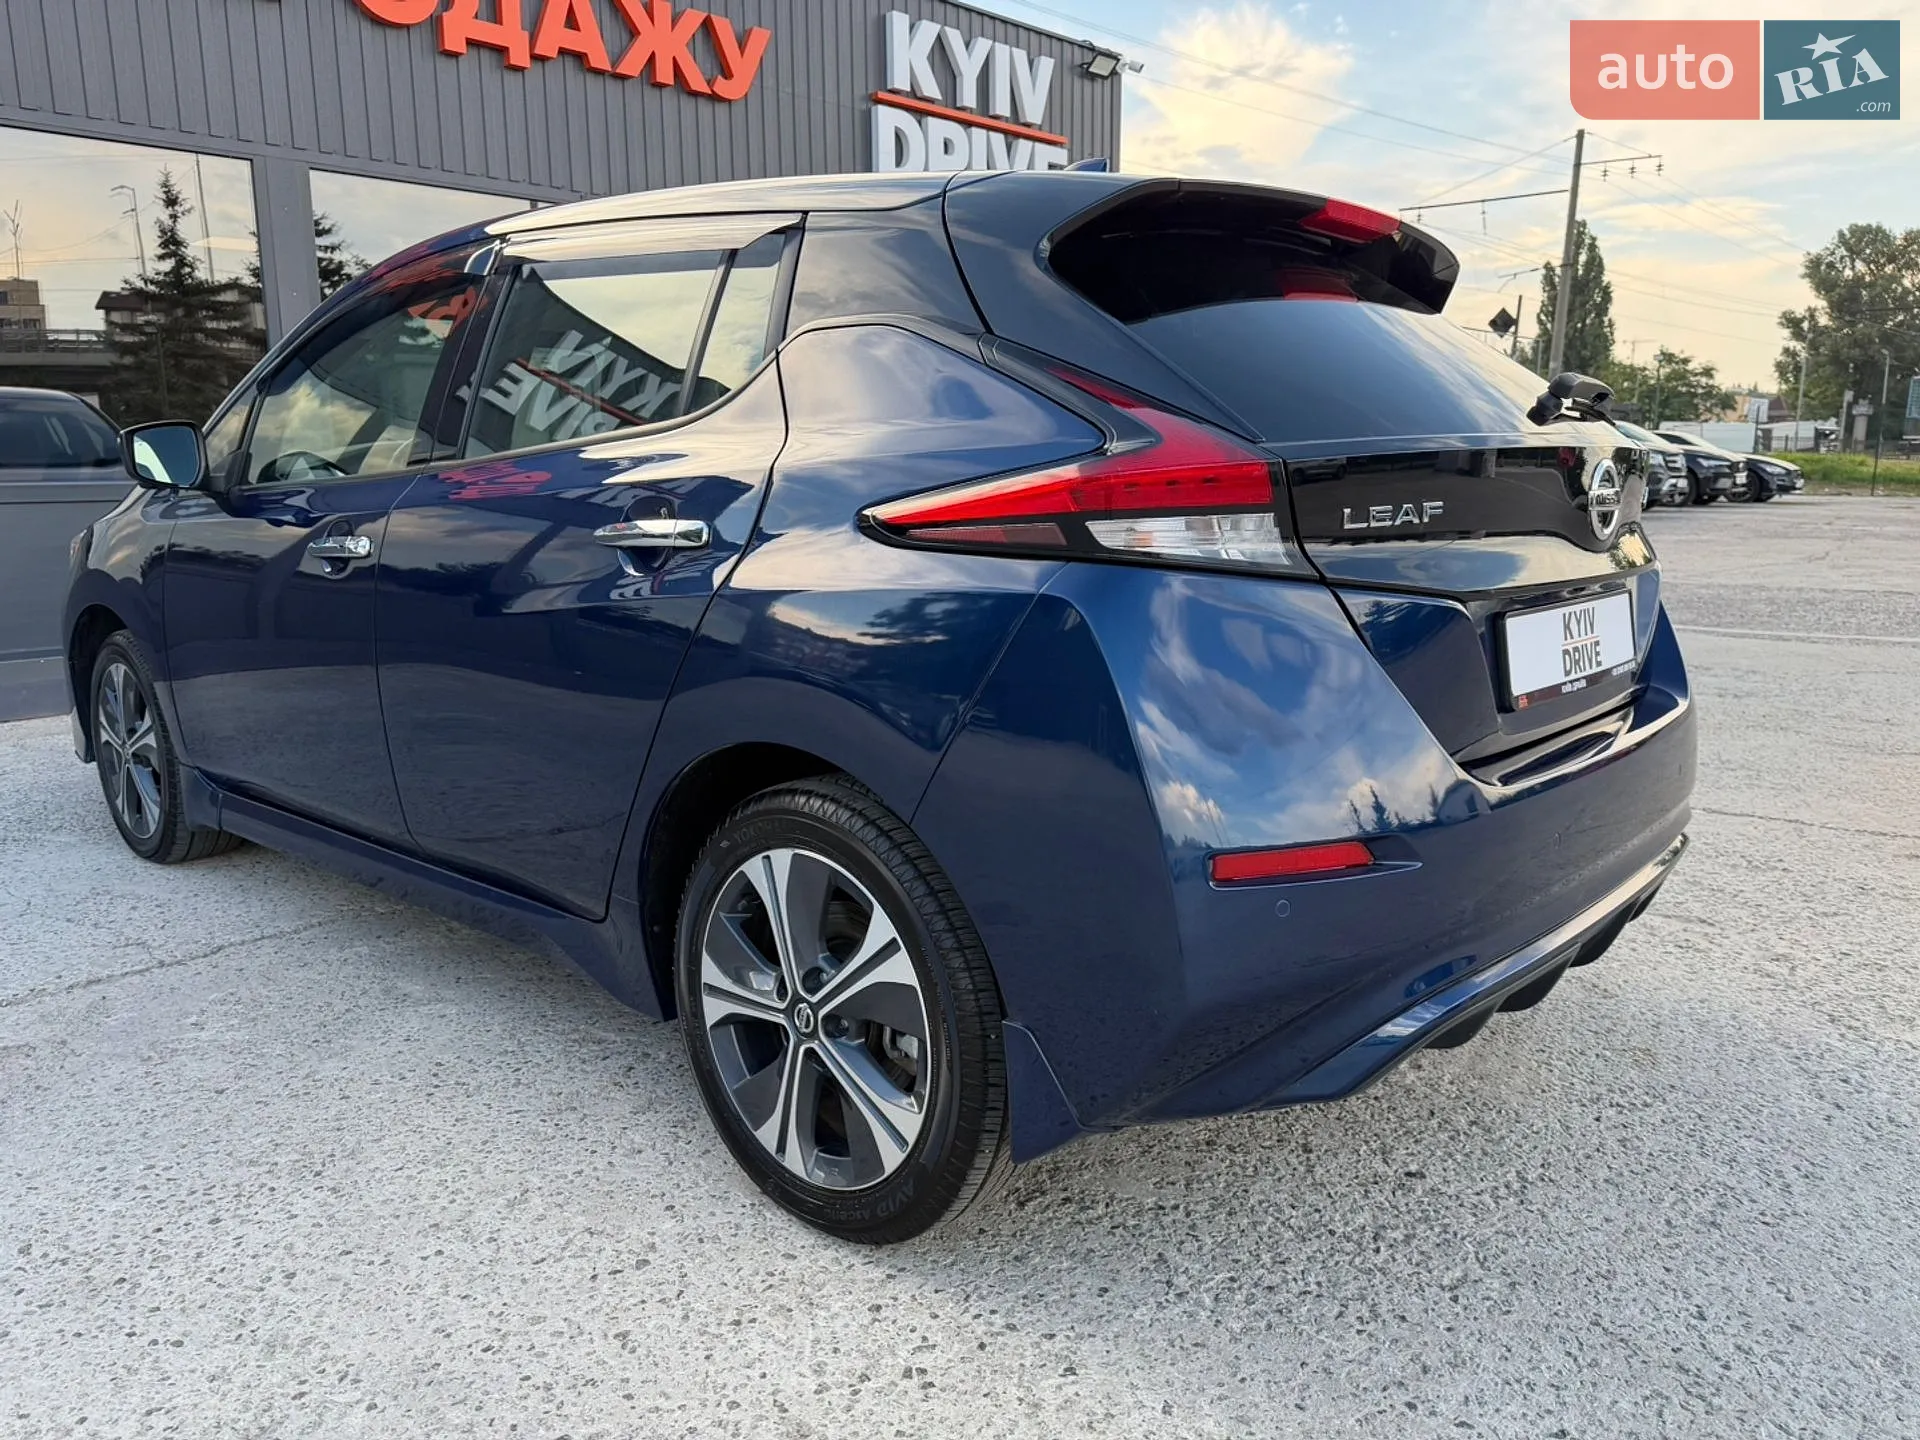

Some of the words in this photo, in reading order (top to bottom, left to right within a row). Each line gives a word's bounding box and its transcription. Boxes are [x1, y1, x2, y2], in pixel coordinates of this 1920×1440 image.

[352, 0, 772, 102] ДАЖУ
[886, 10, 1055, 125] KYIV
[1342, 501, 1444, 530] LEAF
[1562, 606, 1595, 641] KYIV
[1562, 640, 1602, 677] DRIVE
